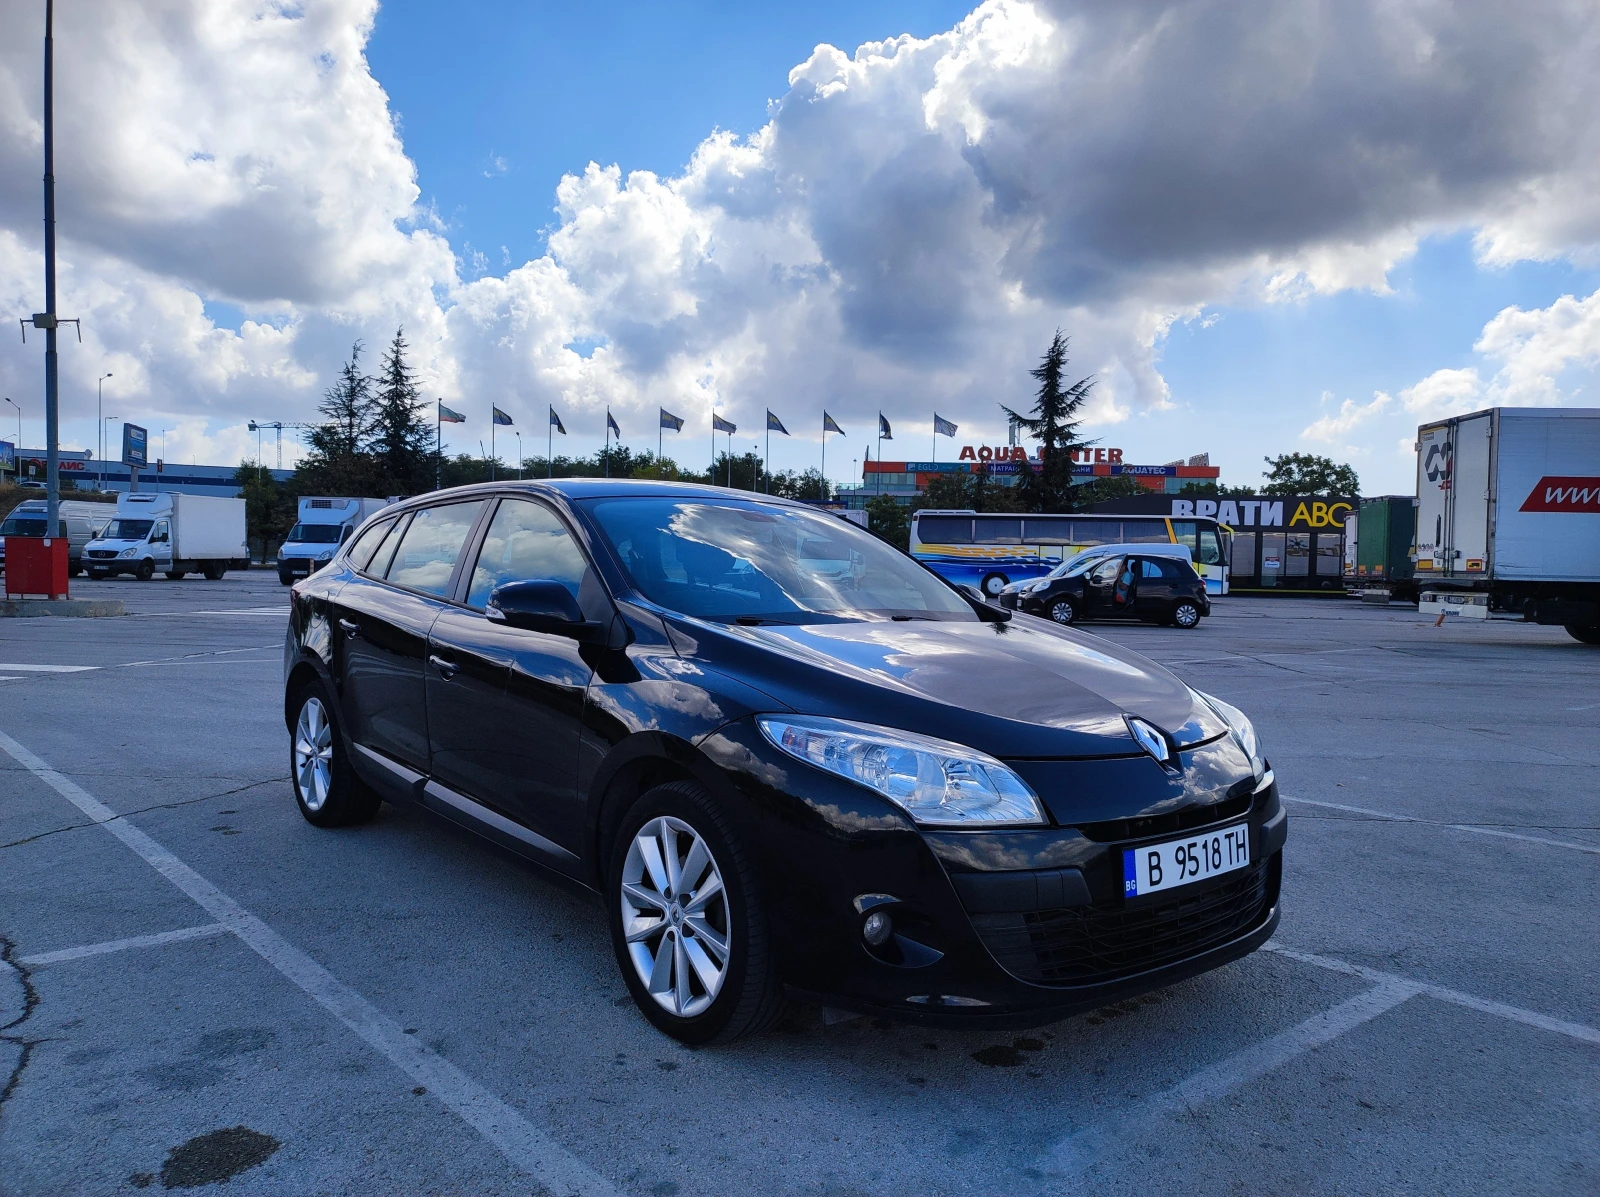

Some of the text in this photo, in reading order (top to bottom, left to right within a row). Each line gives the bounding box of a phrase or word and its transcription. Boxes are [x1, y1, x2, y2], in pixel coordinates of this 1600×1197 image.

[959, 446, 1028, 462] AQUA
[1121, 467, 1166, 475] AQUATEC
[1545, 487, 1600, 505] ww
[1171, 500, 1283, 526] ВРАТИ
[1148, 829, 1246, 887] B 9518 TH
[1126, 880, 1136, 891] BG
